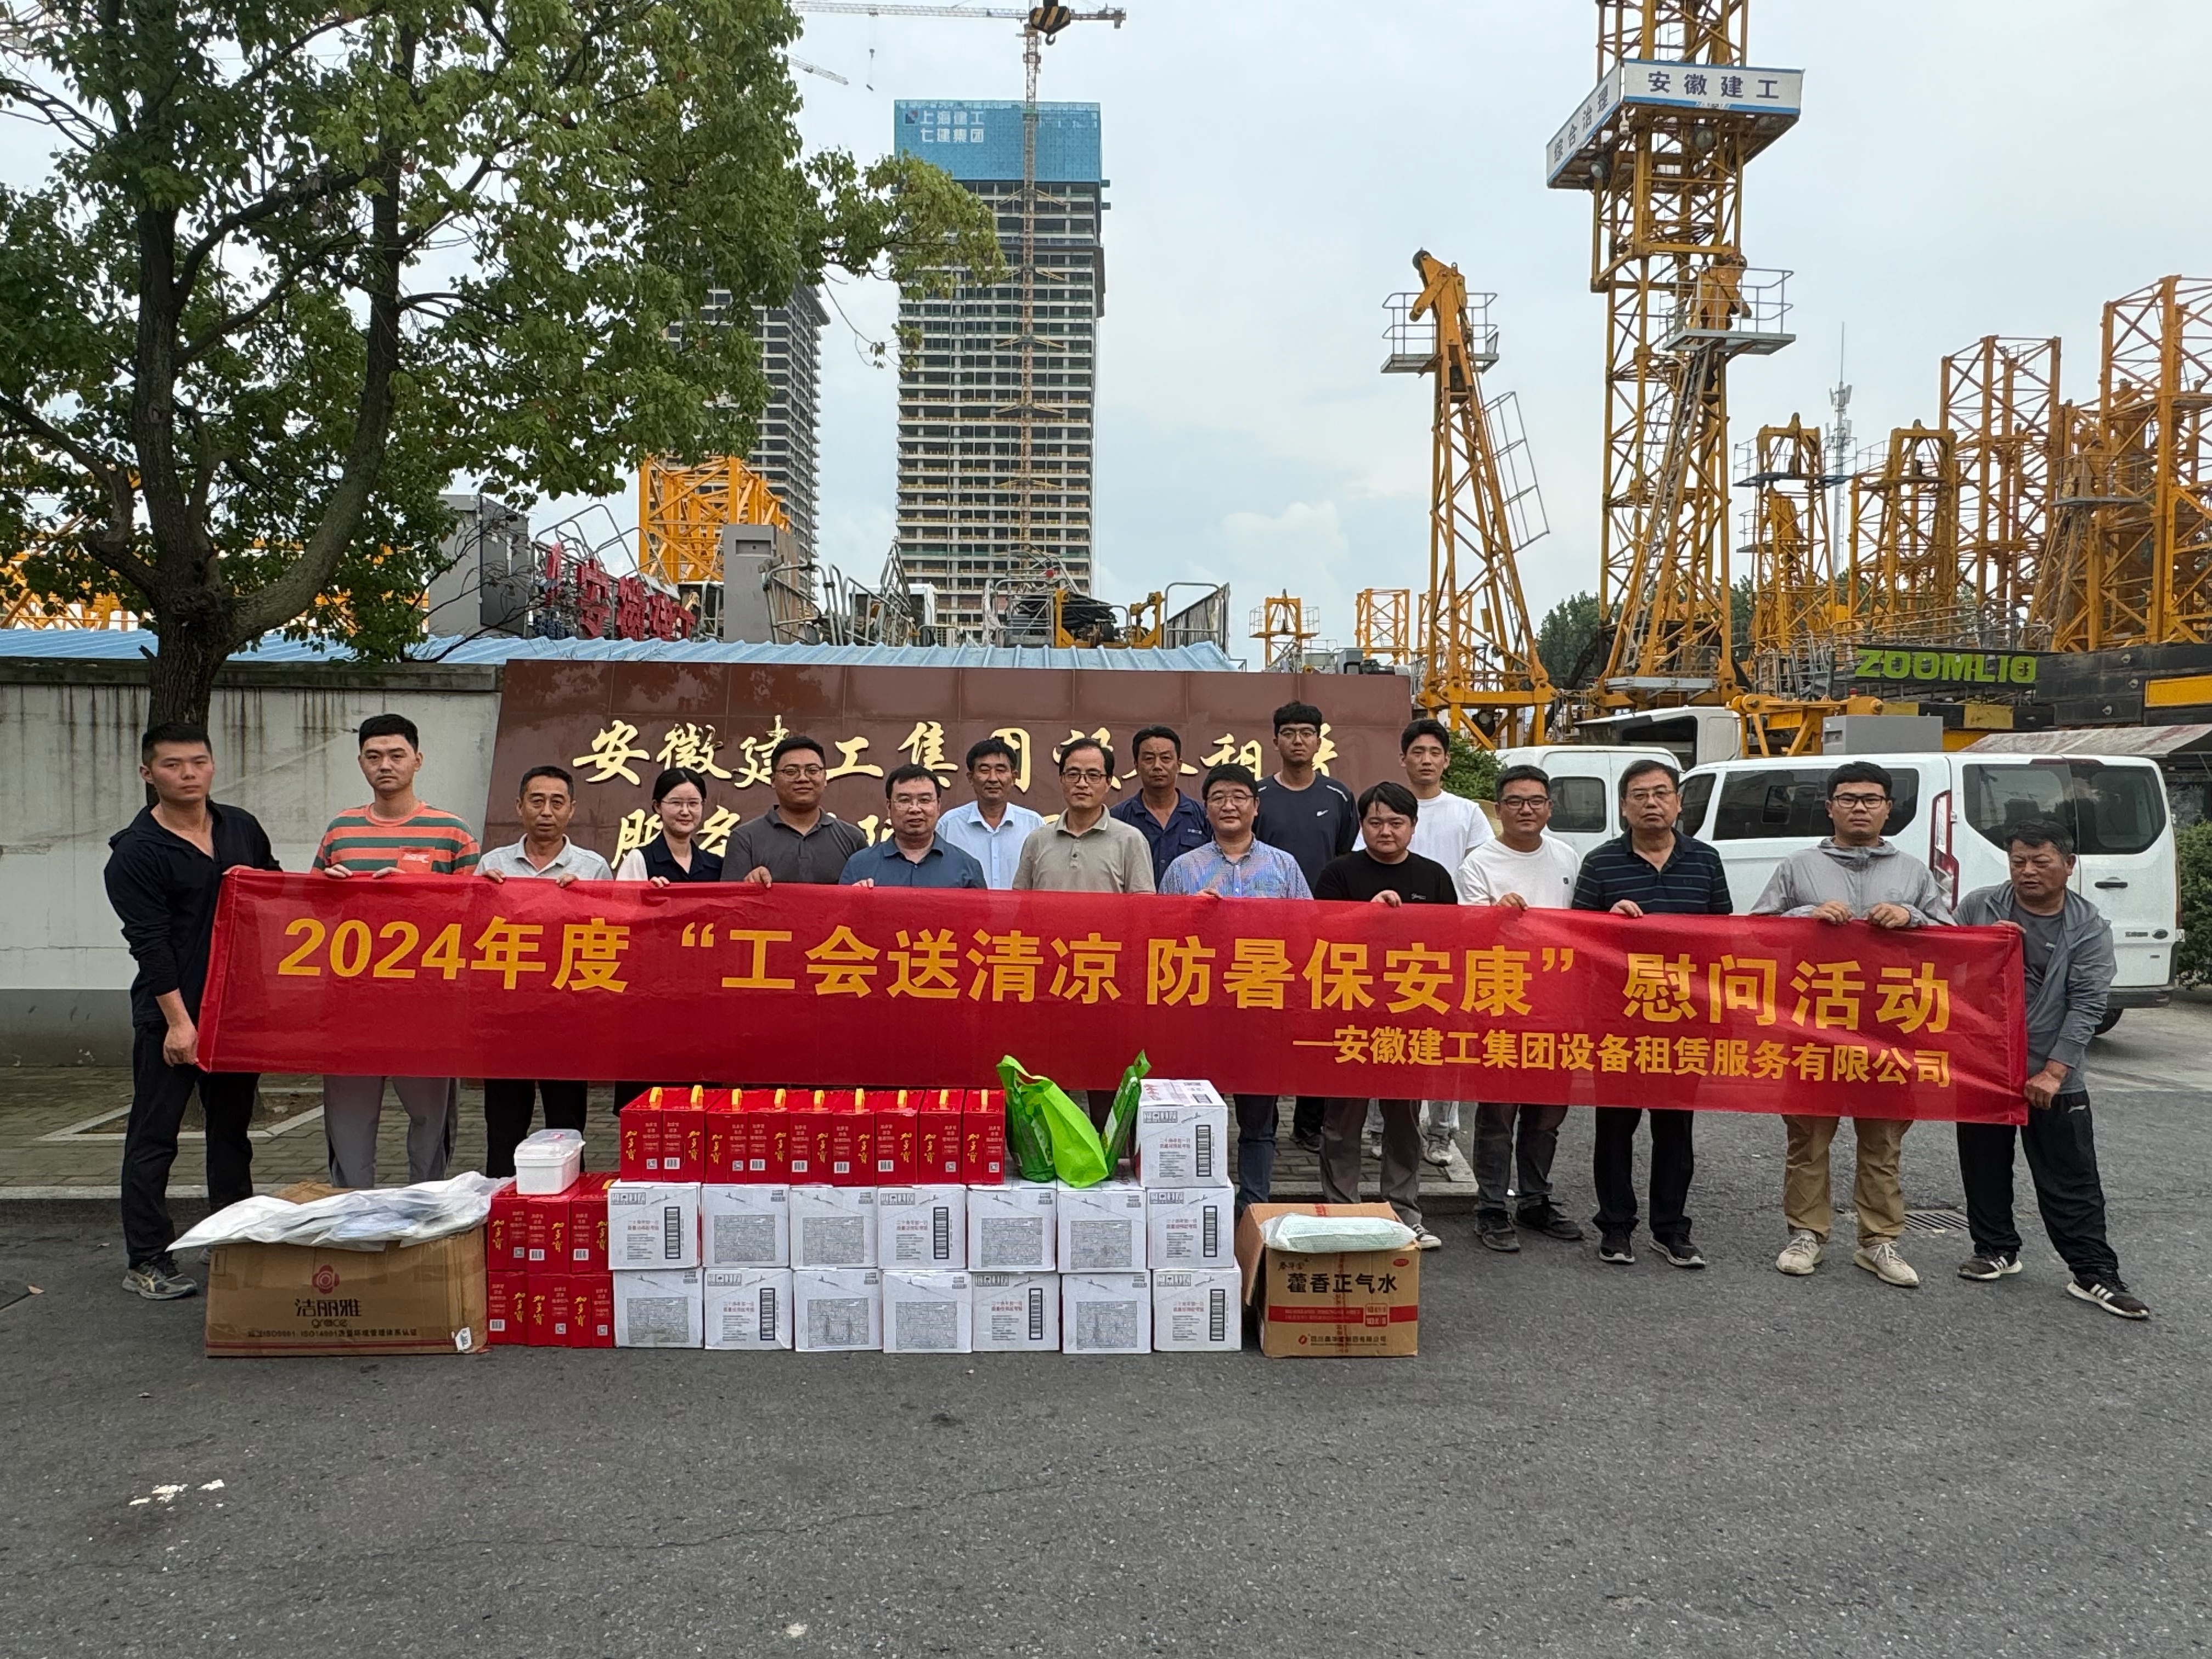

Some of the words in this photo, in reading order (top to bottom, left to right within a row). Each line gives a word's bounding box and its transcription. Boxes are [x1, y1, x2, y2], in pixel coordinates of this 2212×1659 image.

[1648, 71, 1780, 100] 安徽建工
[276, 916, 630, 993] 2024年度
[1622, 952, 1951, 1034] 慰问活动
[1287, 1273, 1397, 1294] 藿香正气水
[295, 1298, 363, 1317] 洁丽雅
